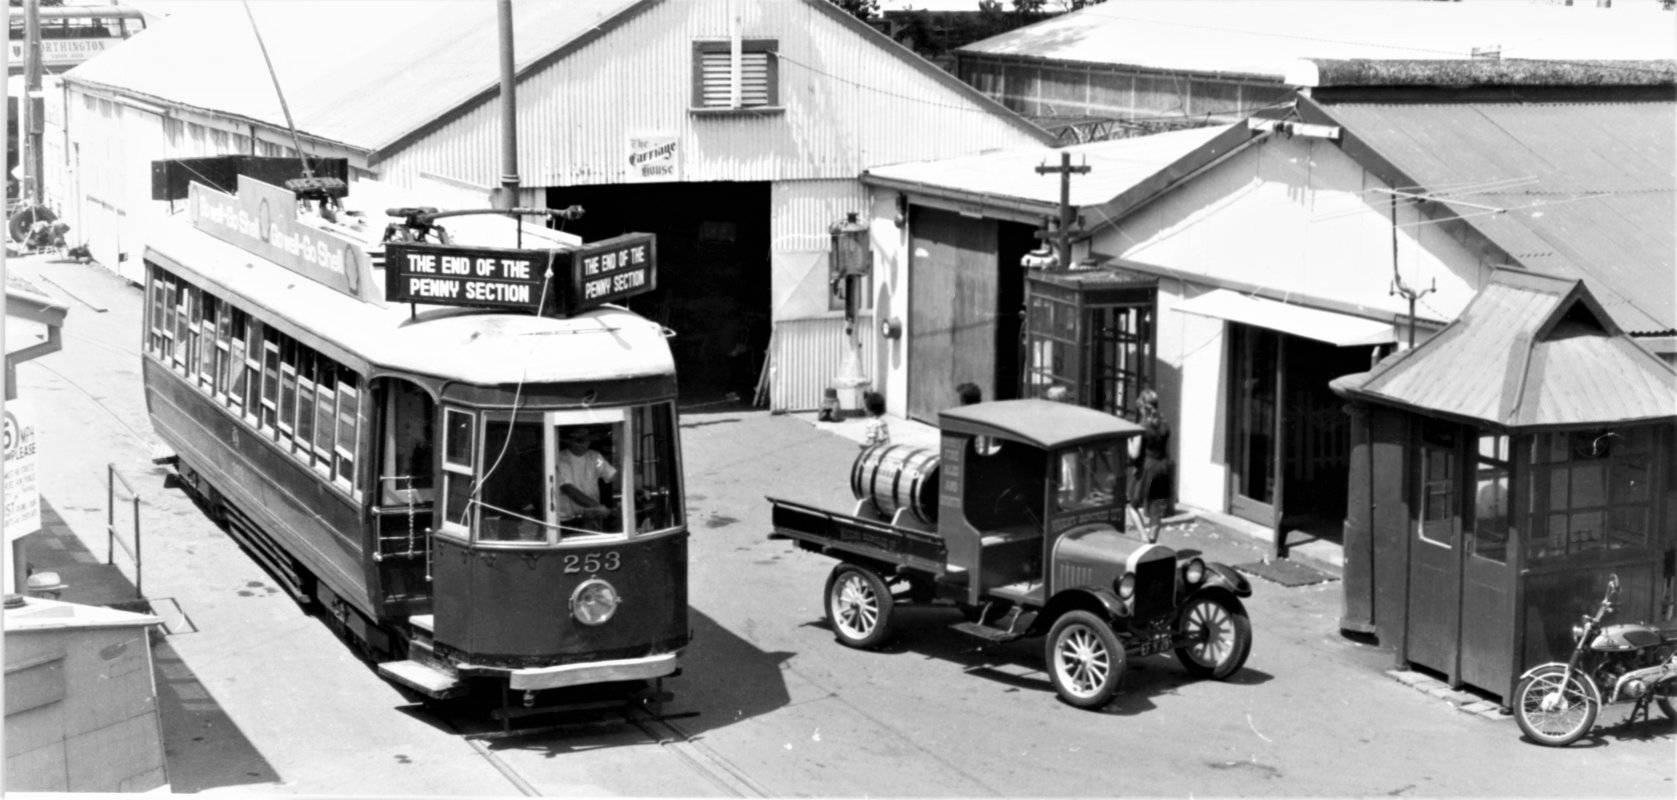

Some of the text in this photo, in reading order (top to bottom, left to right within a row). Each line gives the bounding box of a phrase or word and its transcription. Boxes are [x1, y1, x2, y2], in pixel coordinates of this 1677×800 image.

[41, 41, 104, 52] ORTHINGTON
[629, 142, 676, 167] Carriage
[630, 138, 648, 148] The
[641, 164, 673, 177] House
[317, 240, 344, 274] Shell
[407, 254, 530, 279] THE END OF THE
[584, 246, 645, 276] THE END OF THE
[410, 278, 530, 303] PENNY SECTION
[585, 269, 645, 300] PENNY SECTION
[10, 442, 36, 461] PLEASE
[563, 551, 621, 575] 253
